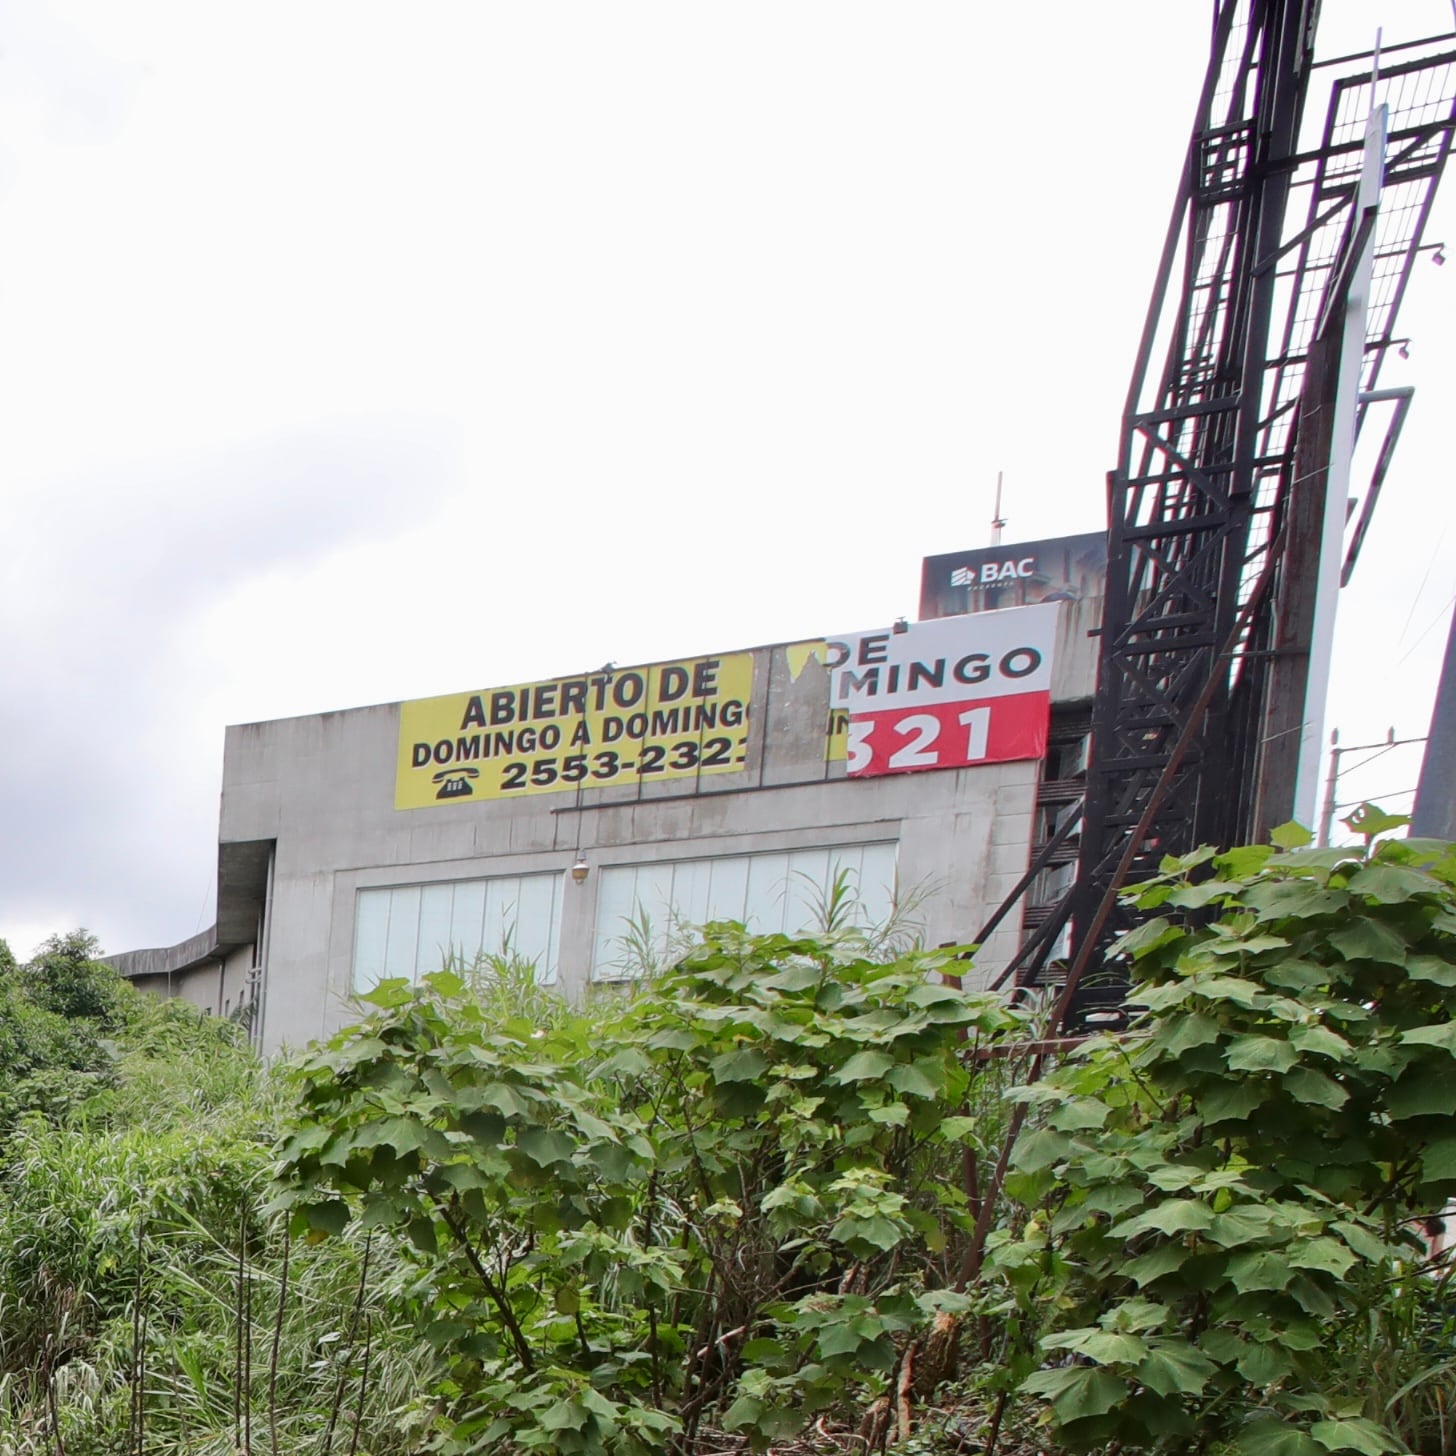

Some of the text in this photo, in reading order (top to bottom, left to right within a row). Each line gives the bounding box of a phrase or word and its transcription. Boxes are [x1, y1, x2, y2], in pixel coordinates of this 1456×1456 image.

[980, 557, 1035, 583] BAC
[460, 660, 720, 730] ABIERTO DE
[411, 699, 751, 768] DOMINGO A DOMING
